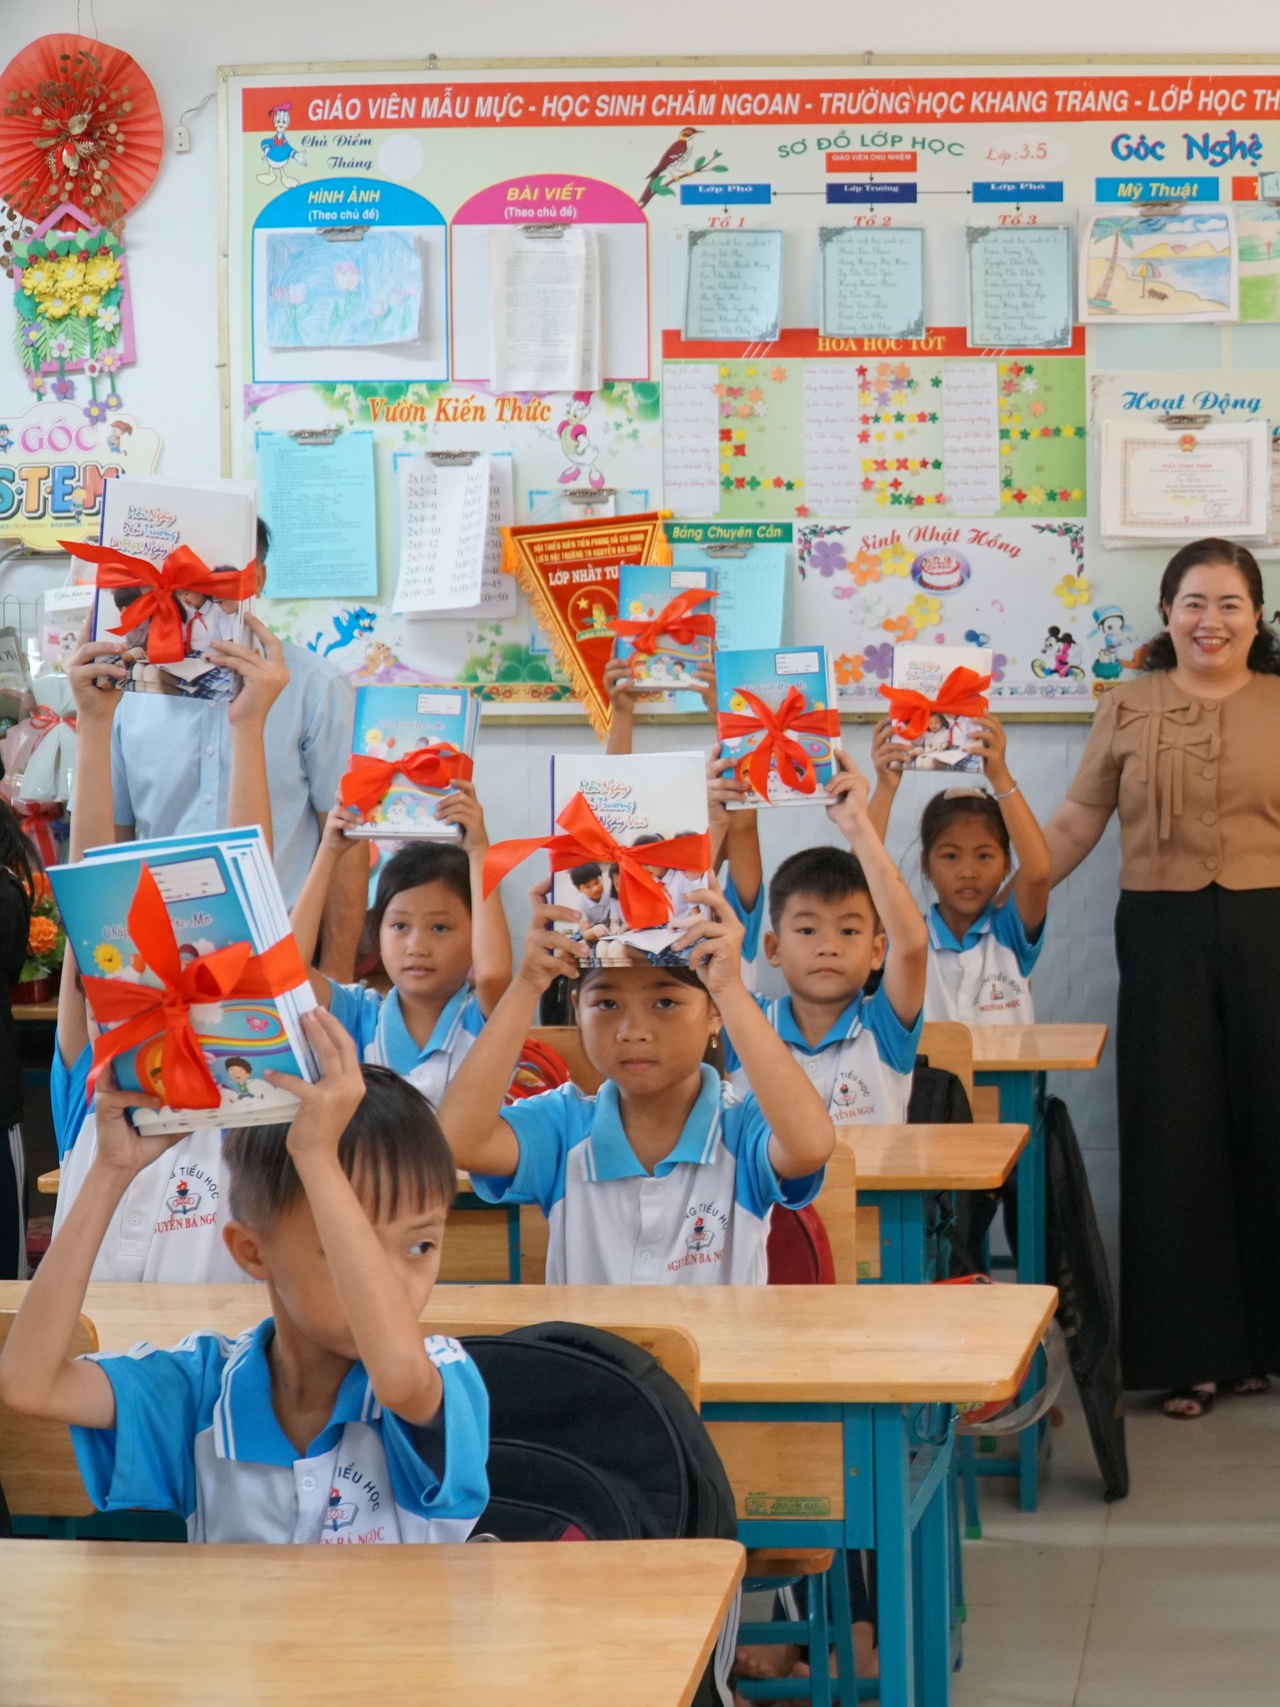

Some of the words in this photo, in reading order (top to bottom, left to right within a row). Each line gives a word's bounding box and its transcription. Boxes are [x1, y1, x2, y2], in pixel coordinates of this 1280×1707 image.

[307, 94, 361, 121] GIÁO
[367, 91, 418, 120] VIÊN
[421, 87, 471, 119] MẪU
[475, 94, 524, 122] MỰC
[542, 93, 589, 121] HỌC
[595, 93, 646, 117] SINH
[652, 88, 714, 116] CHĂM
[720, 92, 800, 116] NGOAN
[820, 86, 910, 114] TRƯỜNG
[916, 90, 964, 118] HỌC
[970, 90, 1047, 113] KHANG
[1055, 89, 1132, 113] TRANG
[1148, 85, 1193, 112] LỚP
[1198, 89, 1246, 116] HỌC
[300, 134, 328, 149] Chủ
[332, 132, 372, 148] Điểm
[778, 138, 808, 158] SƠ
[816, 129, 852, 151] ĐỒ
[860, 129, 904, 149] LỚP
[911, 137, 967, 159] HỌC
[1111, 132, 1166, 162] Góc
[1183, 129, 1263, 168] Nghệ
[1020, 141, 1049, 160] 3.5
[326, 155, 372, 171] Tháng
[307, 187, 344, 205] HÌNH
[347, 184, 381, 204] ẢNH
[506, 183, 539, 201] BÀI
[541, 181, 586, 202] VIẾT
[698, 183, 726, 194] Lớp
[728, 182, 753, 192] Phó
[843, 184, 863, 193] Lớp
[990, 181, 1017, 193] Lớp
[1020, 181, 1046, 191] Phó
[1116, 182, 1146, 198] Mỹ
[1150, 181, 1199, 199] Thuật
[308, 208, 338, 223] (Theo
[339, 207, 361, 222] chủ
[361, 207, 380, 222] đề)
[504, 205, 535, 220] (Theo
[536, 205, 558, 219] chủ
[558, 205, 578, 220] đề)
[707, 215, 737, 228] Tổ
[737, 217, 746, 228] 1
[853, 214, 880, 227] Tổ
[881, 216, 893, 227] 2
[998, 213, 1025, 226] Tổ
[1026, 214, 1038, 226] 3
[817, 339, 858, 353] HOA
[862, 338, 903, 356] HỌC
[908, 329, 946, 352] TỐT
[368, 397, 427, 423] Vườn
[435, 394, 487, 423] Kiến
[495, 393, 552, 422] Thức
[1122, 390, 1186, 416] Hoạt
[1192, 390, 1263, 416] Động
[19, 417, 98, 454] GÓC
[148, 505, 177, 525] Ngày
[672, 525, 703, 540] Bảng
[706, 525, 752, 541] Chuyên
[755, 523, 783, 539] Cần
[860, 525, 901, 552] Sinh
[908, 524, 960, 544] Nhật
[967, 527, 1023, 559] Hồng
[548, 568, 570, 586] LỚP
[601, 778, 632, 798] Ngày
[179, 1163, 204, 1180] TIỂU
[203, 1176, 220, 1200] HỌC
[185, 1213, 199, 1229] BÁ
[337, 1461, 363, 1484] IỂU
[362, 1481, 382, 1513] HỌC
